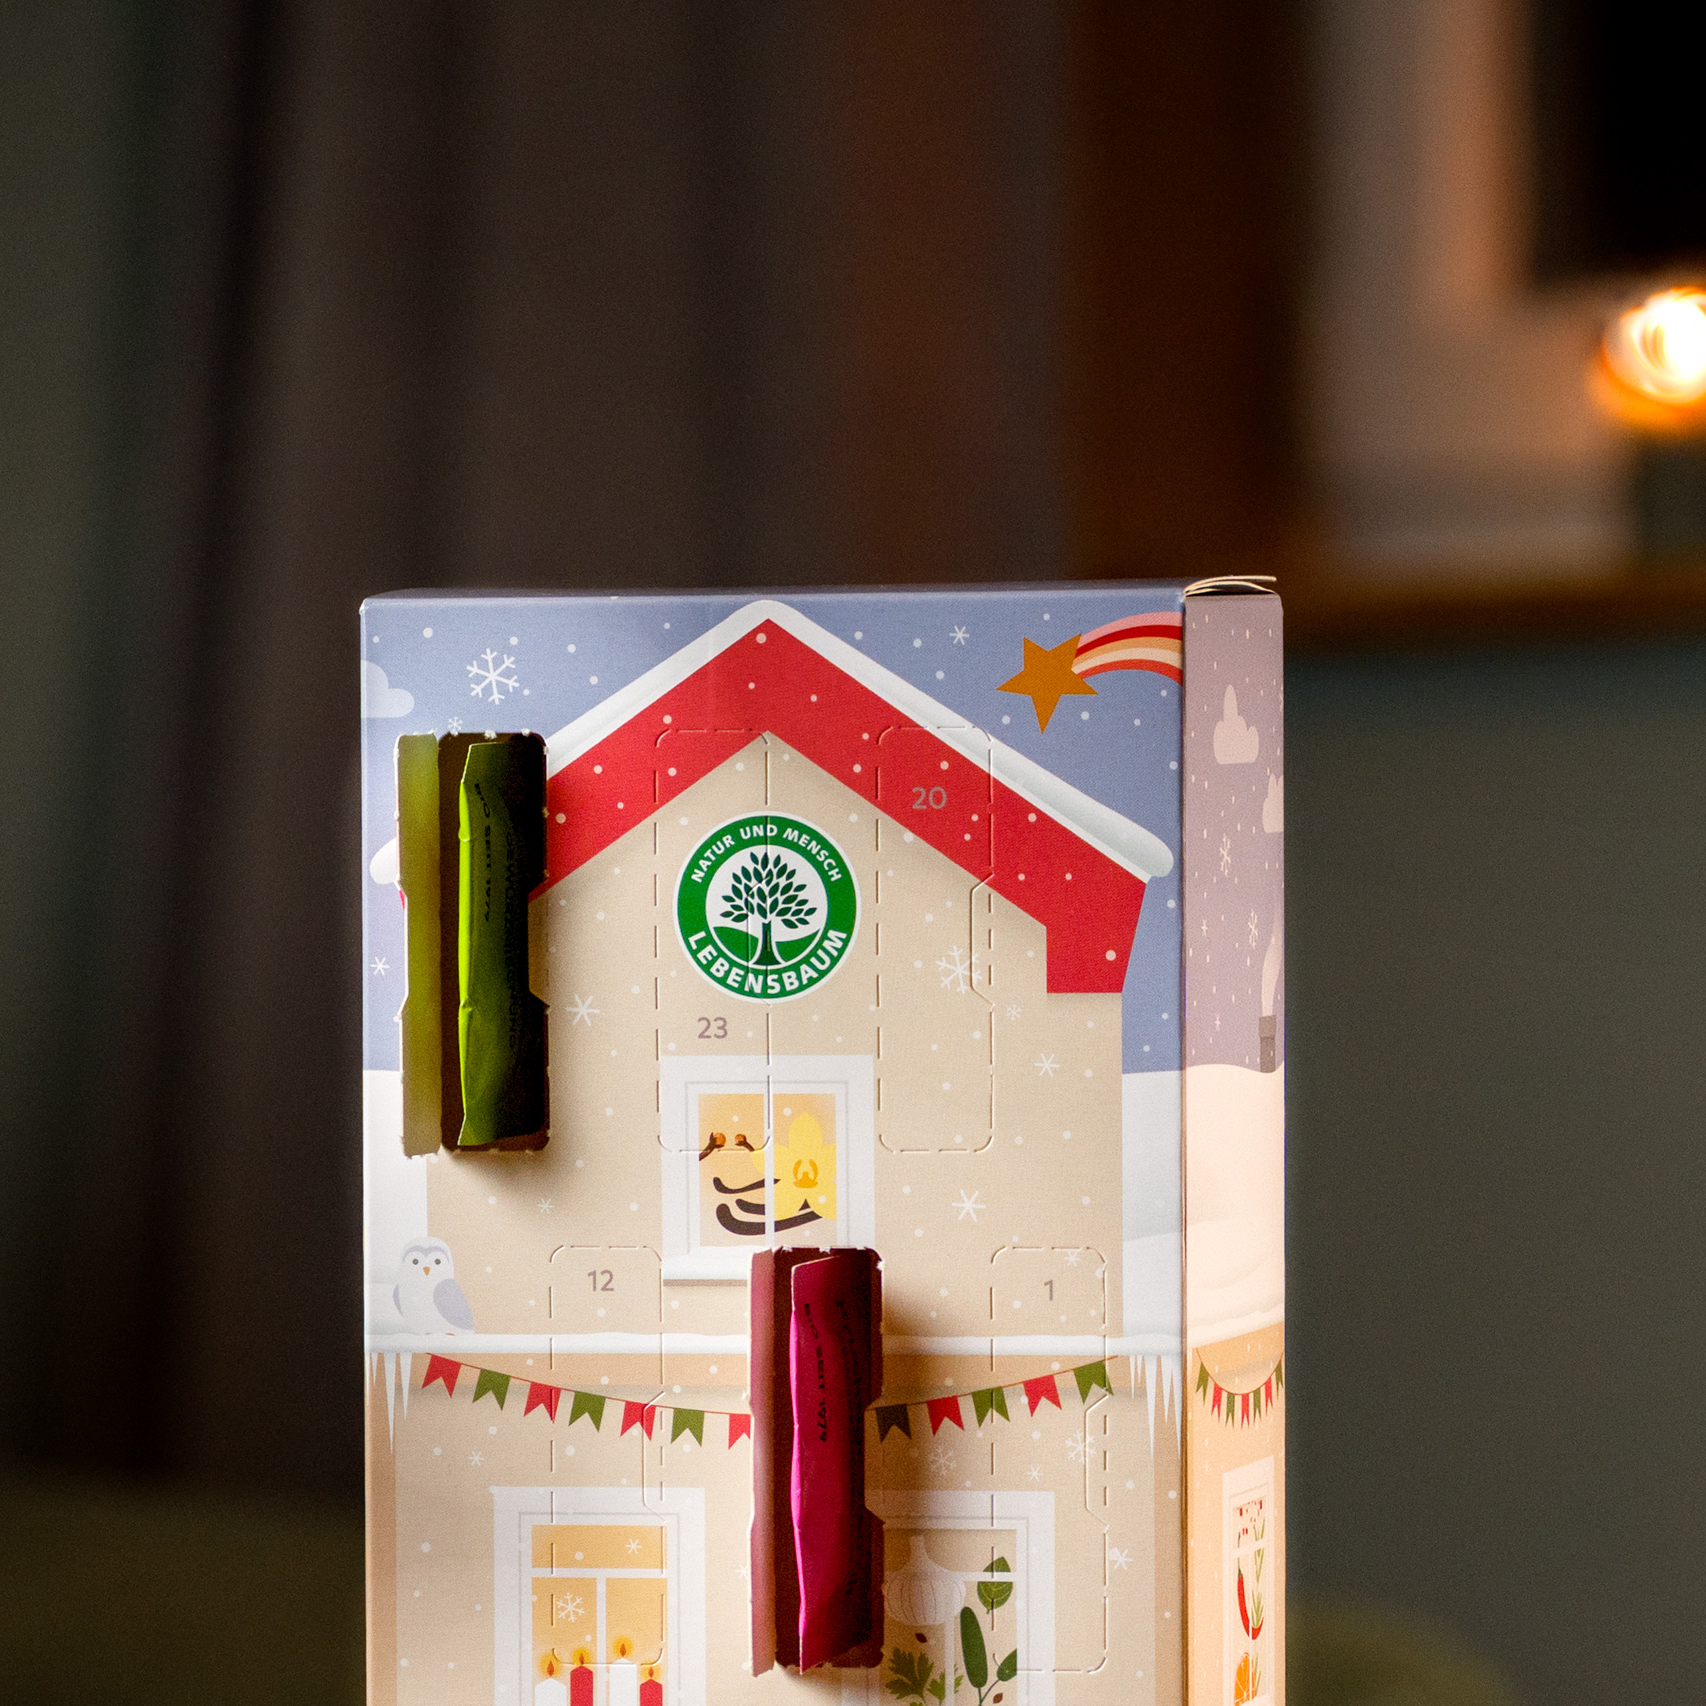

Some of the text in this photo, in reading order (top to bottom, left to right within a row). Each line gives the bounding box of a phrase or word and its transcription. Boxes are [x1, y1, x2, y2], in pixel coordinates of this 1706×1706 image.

[911, 786, 947, 810] 20
[691, 824, 842, 883] NATUR UND MENSCH
[688, 929, 847, 995] LEBENSBAUM
[697, 1017, 728, 1039] 23
[587, 1270, 614, 1291] 12
[1044, 1280, 1053, 1301] 1
